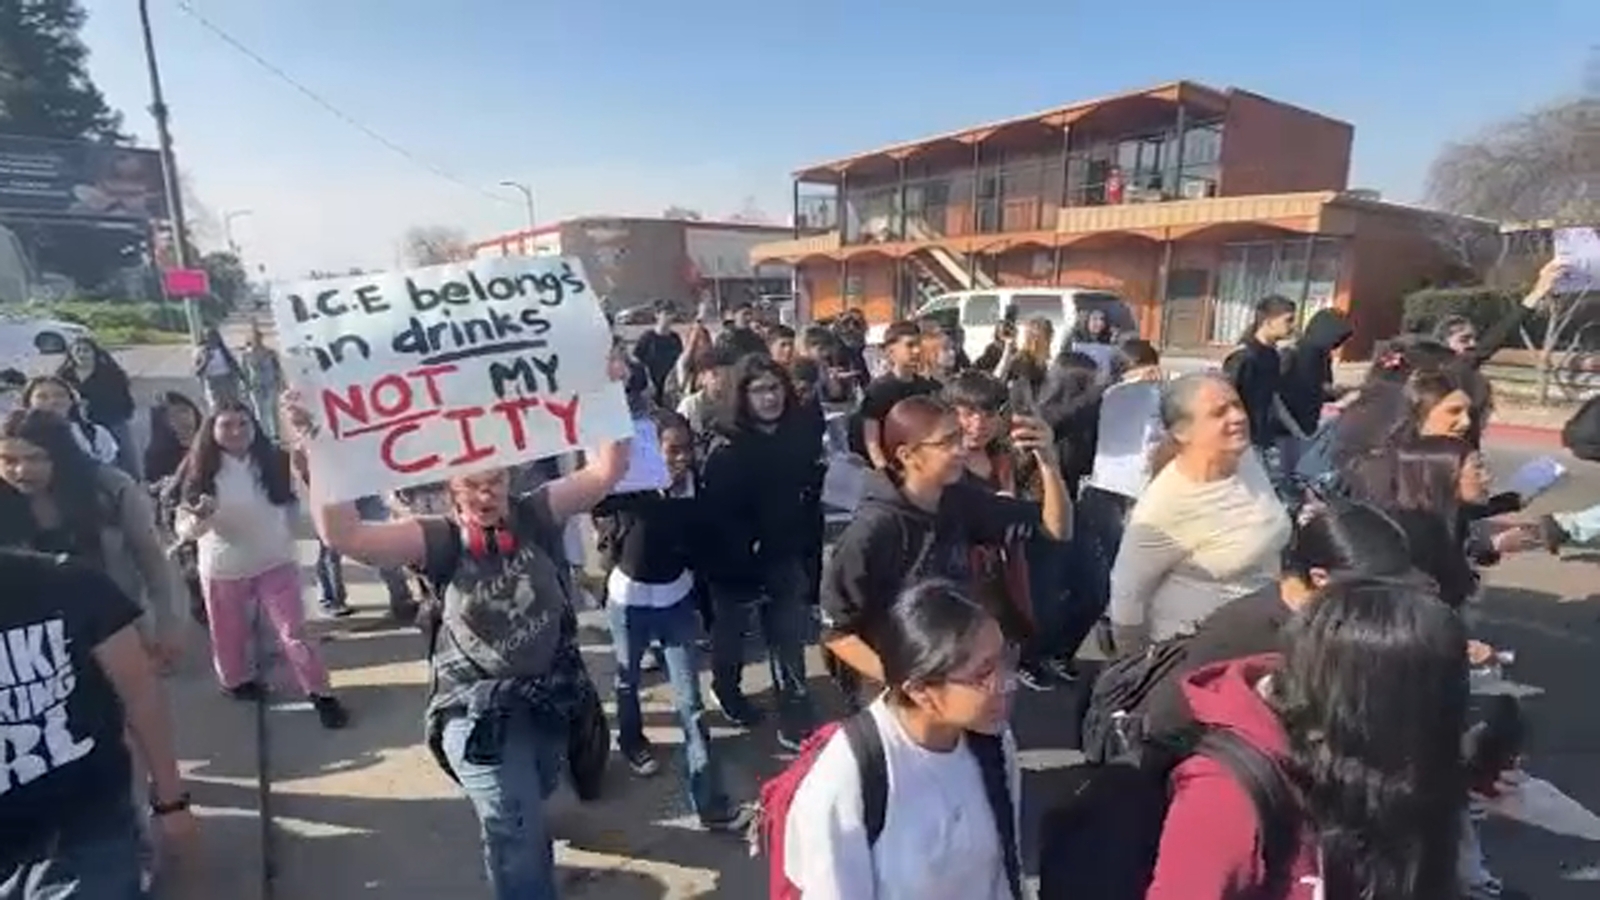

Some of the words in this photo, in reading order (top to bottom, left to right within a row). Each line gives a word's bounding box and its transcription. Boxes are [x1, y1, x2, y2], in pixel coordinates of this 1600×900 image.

[287, 284, 391, 323] I.C.E
[300, 334, 370, 371] in
[392, 308, 550, 355] drinks
[322, 365, 458, 439] NOT
[488, 354, 559, 398] MY
[381, 395, 580, 473] CITY
